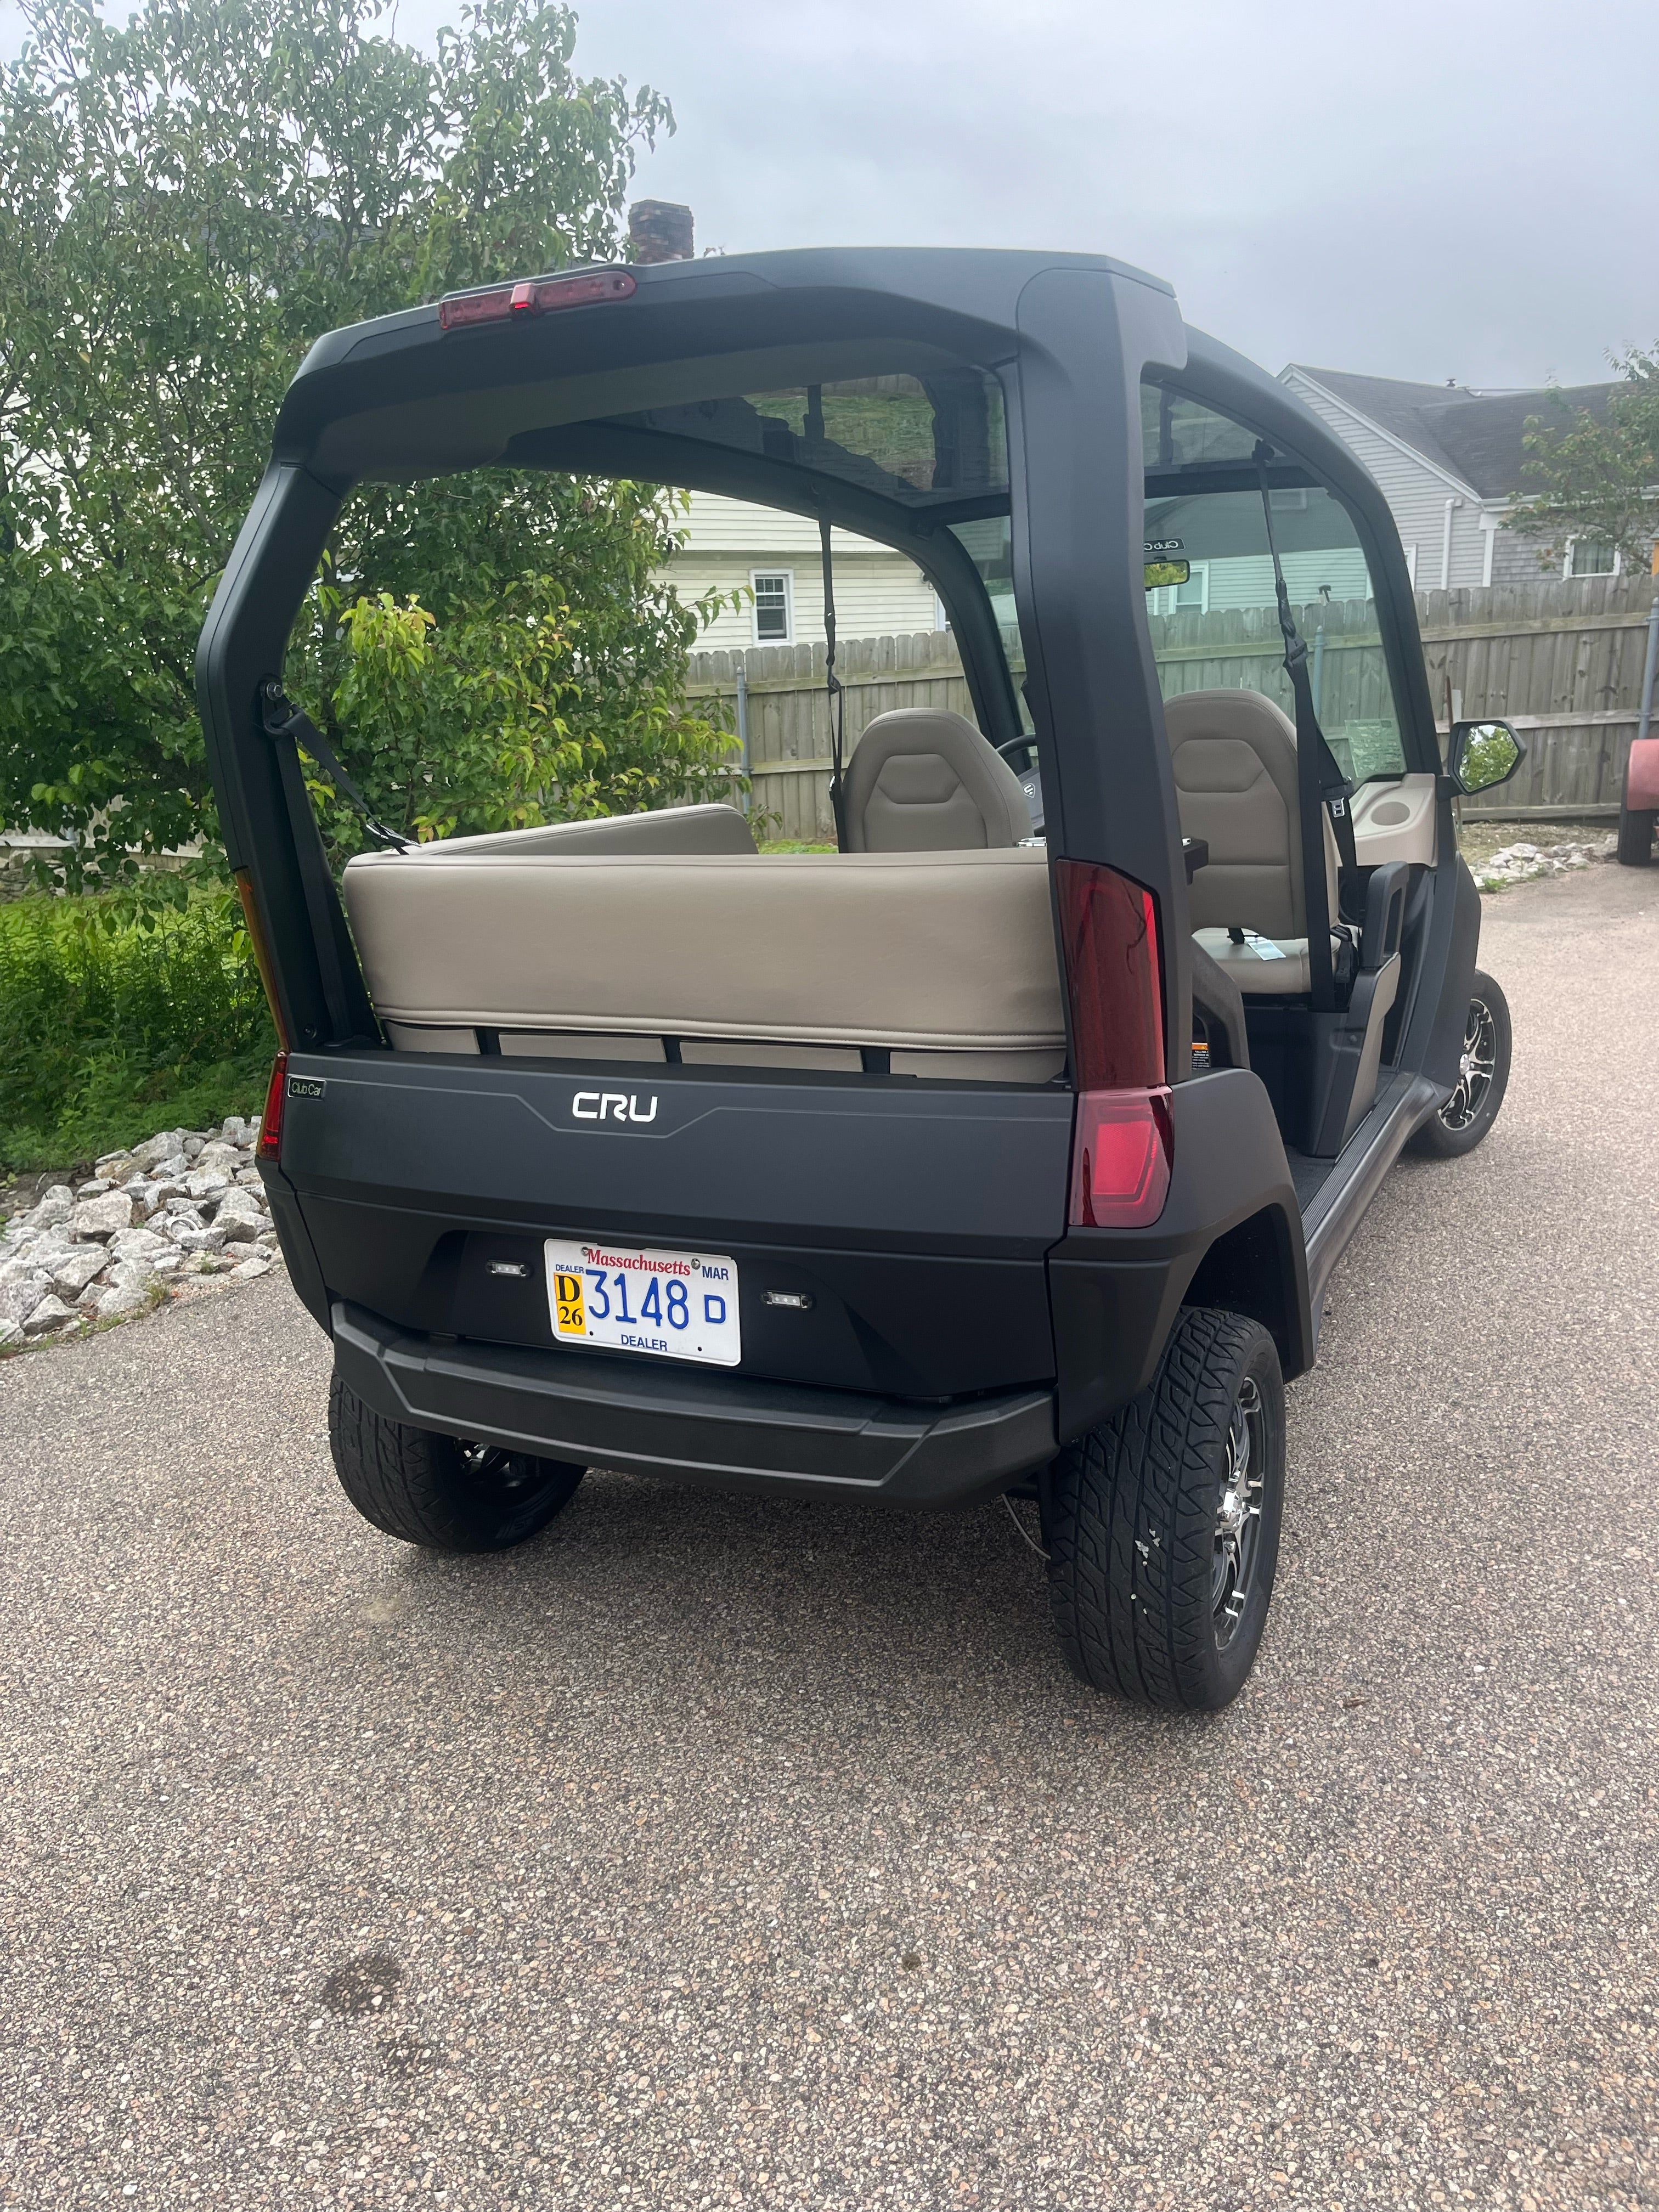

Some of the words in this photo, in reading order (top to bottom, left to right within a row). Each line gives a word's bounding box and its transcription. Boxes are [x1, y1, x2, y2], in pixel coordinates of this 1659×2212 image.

[572, 1092, 658, 1122] CRU
[555, 1264, 584, 1274] DEALER
[587, 1248, 690, 1276] Massachusetts
[702, 1266, 729, 1280] MAR
[556, 1275, 580, 1302] D
[585, 1268, 689, 1330] 3148
[704, 1294, 726, 1324] D
[559, 1306, 583, 1327] 26
[621, 1334, 668, 1352] DEALER
